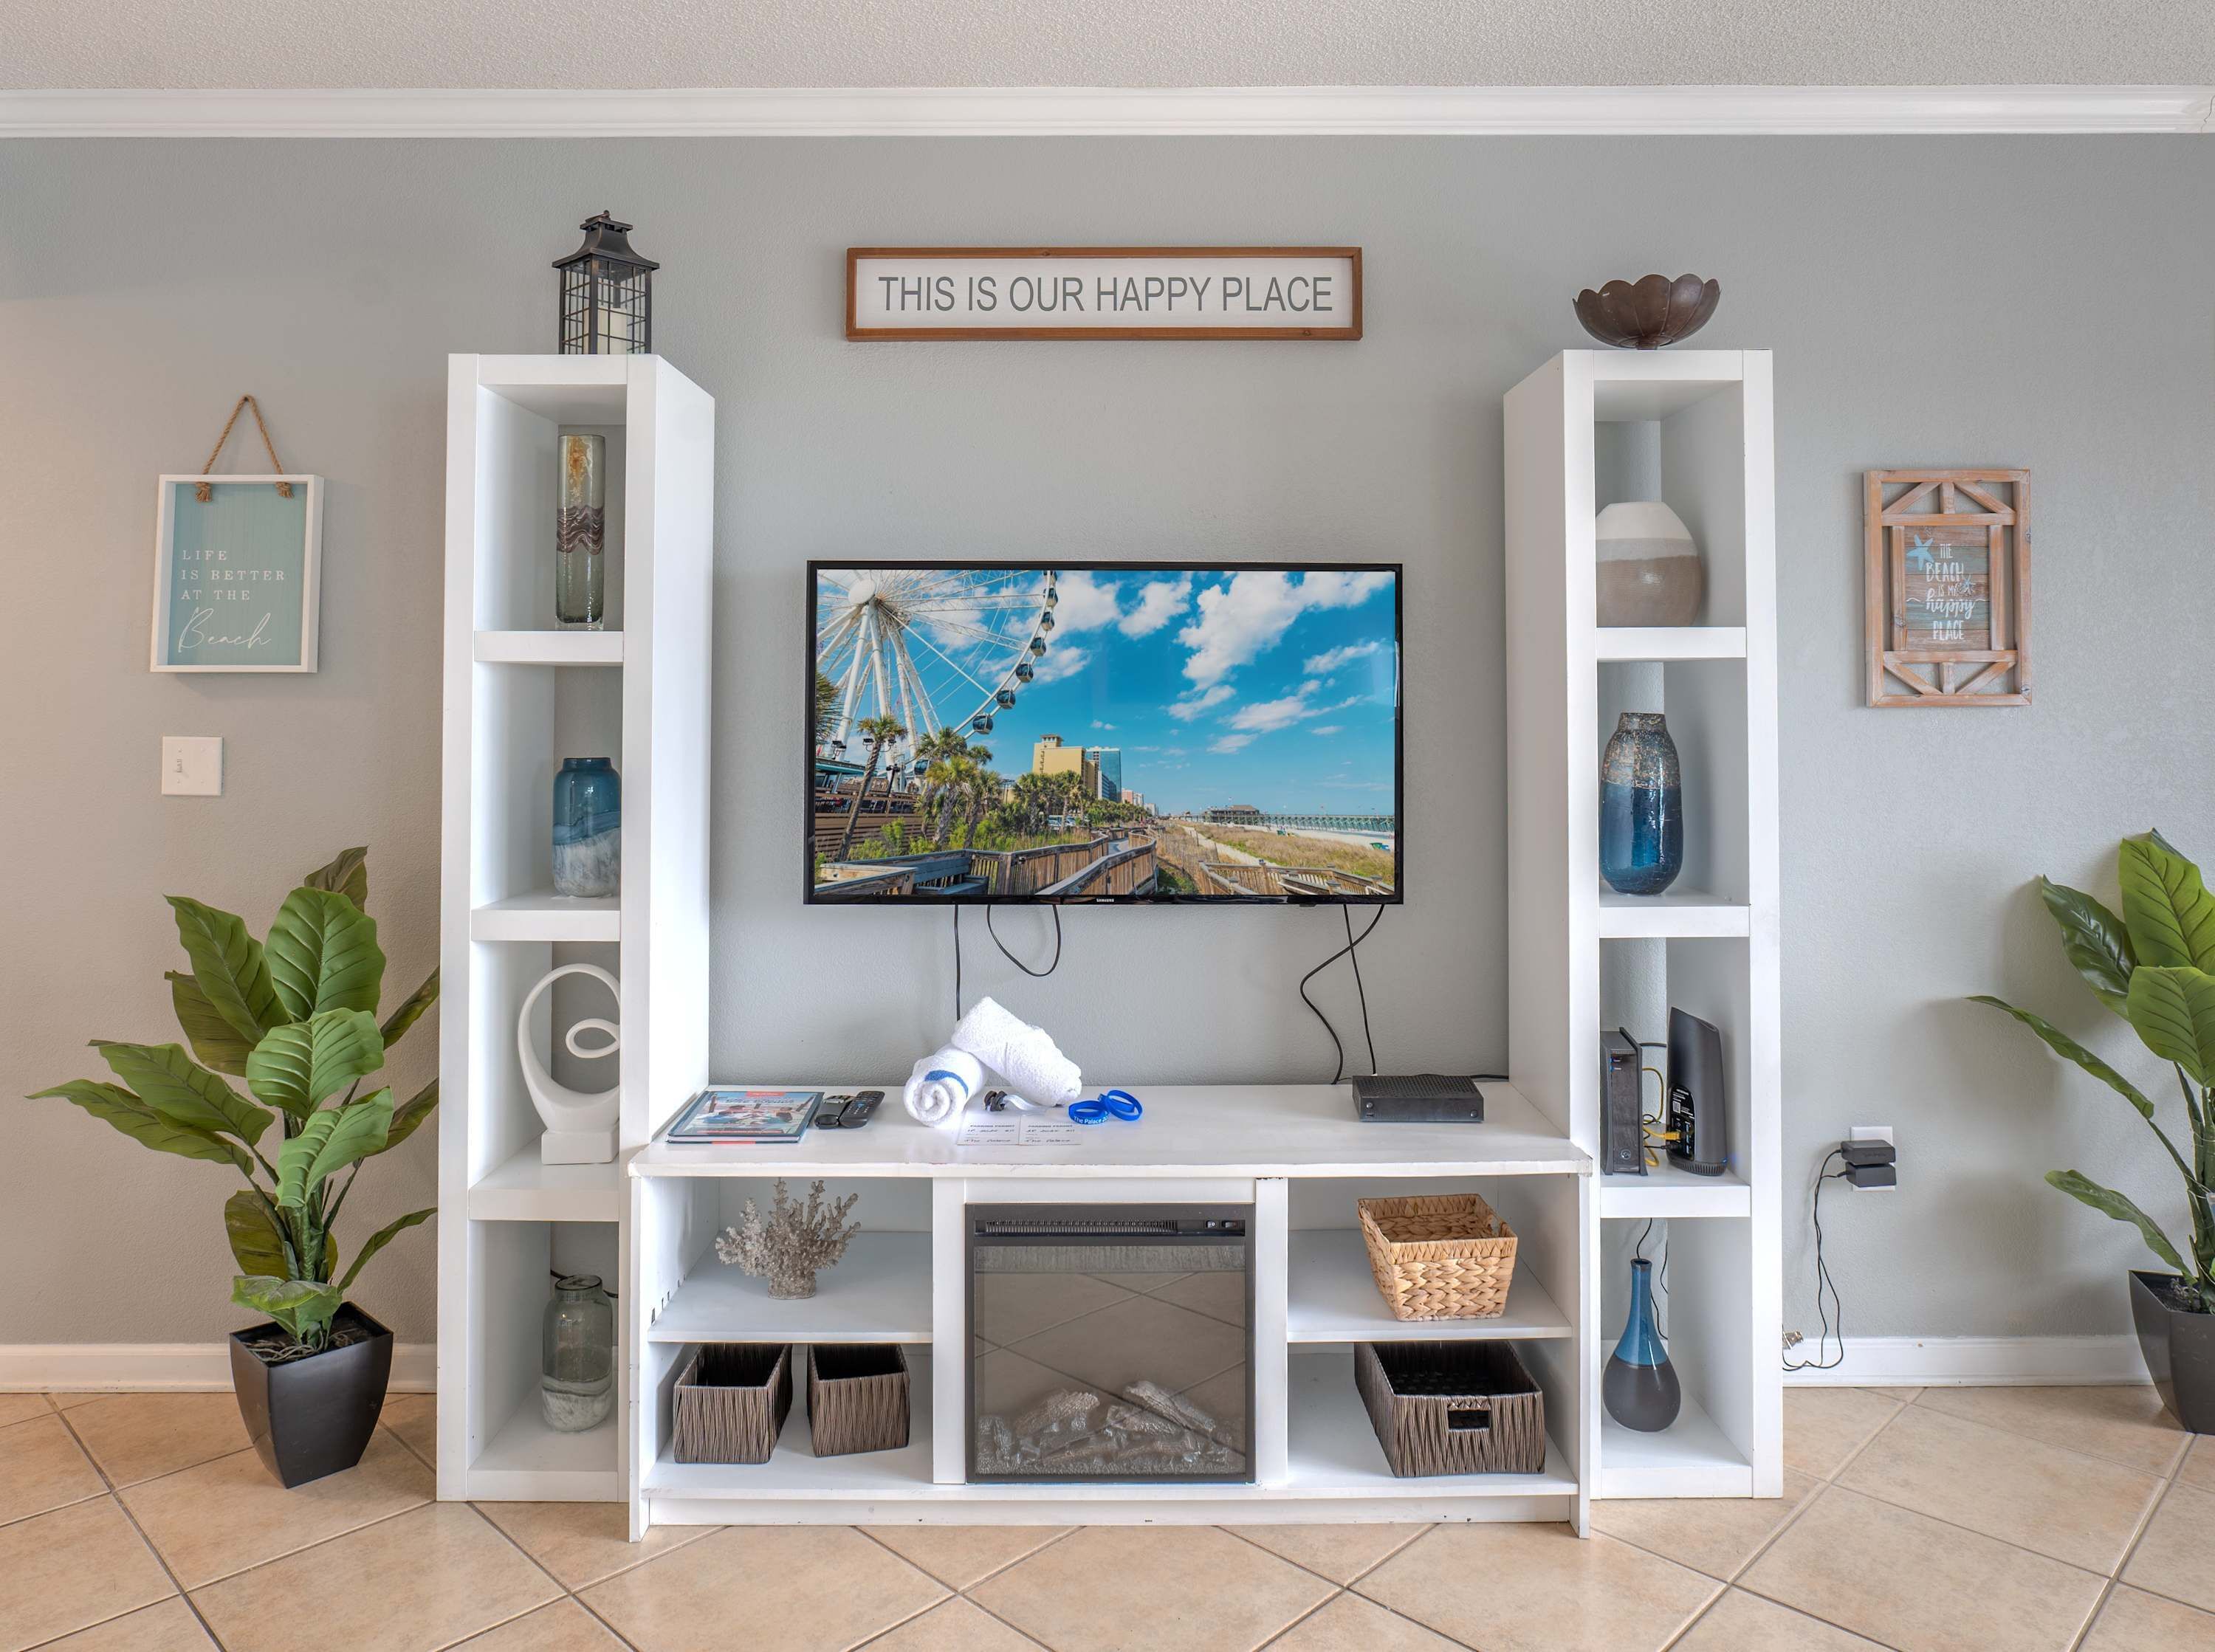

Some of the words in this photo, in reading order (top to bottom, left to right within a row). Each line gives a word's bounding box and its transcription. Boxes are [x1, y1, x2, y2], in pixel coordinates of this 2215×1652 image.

[879, 276, 955, 312] THIS
[967, 276, 997, 312] IS
[1009, 276, 1084, 312] OUR
[1096, 276, 1211, 312] HAPPY
[1223, 276, 1333, 312] PLACE
[182, 550, 227, 560] LIFE
[1940, 543, 1953, 559] THE
[181, 570, 199, 579] IS
[211, 570, 284, 580] BETTER
[1926, 562, 1964, 582] BEACH
[181, 590, 202, 600] AT
[214, 590, 250, 600] THE
[1926, 588, 1976, 619] happy
[178, 607, 272, 653] Beach
[1932, 620, 1965, 641] PLACE
